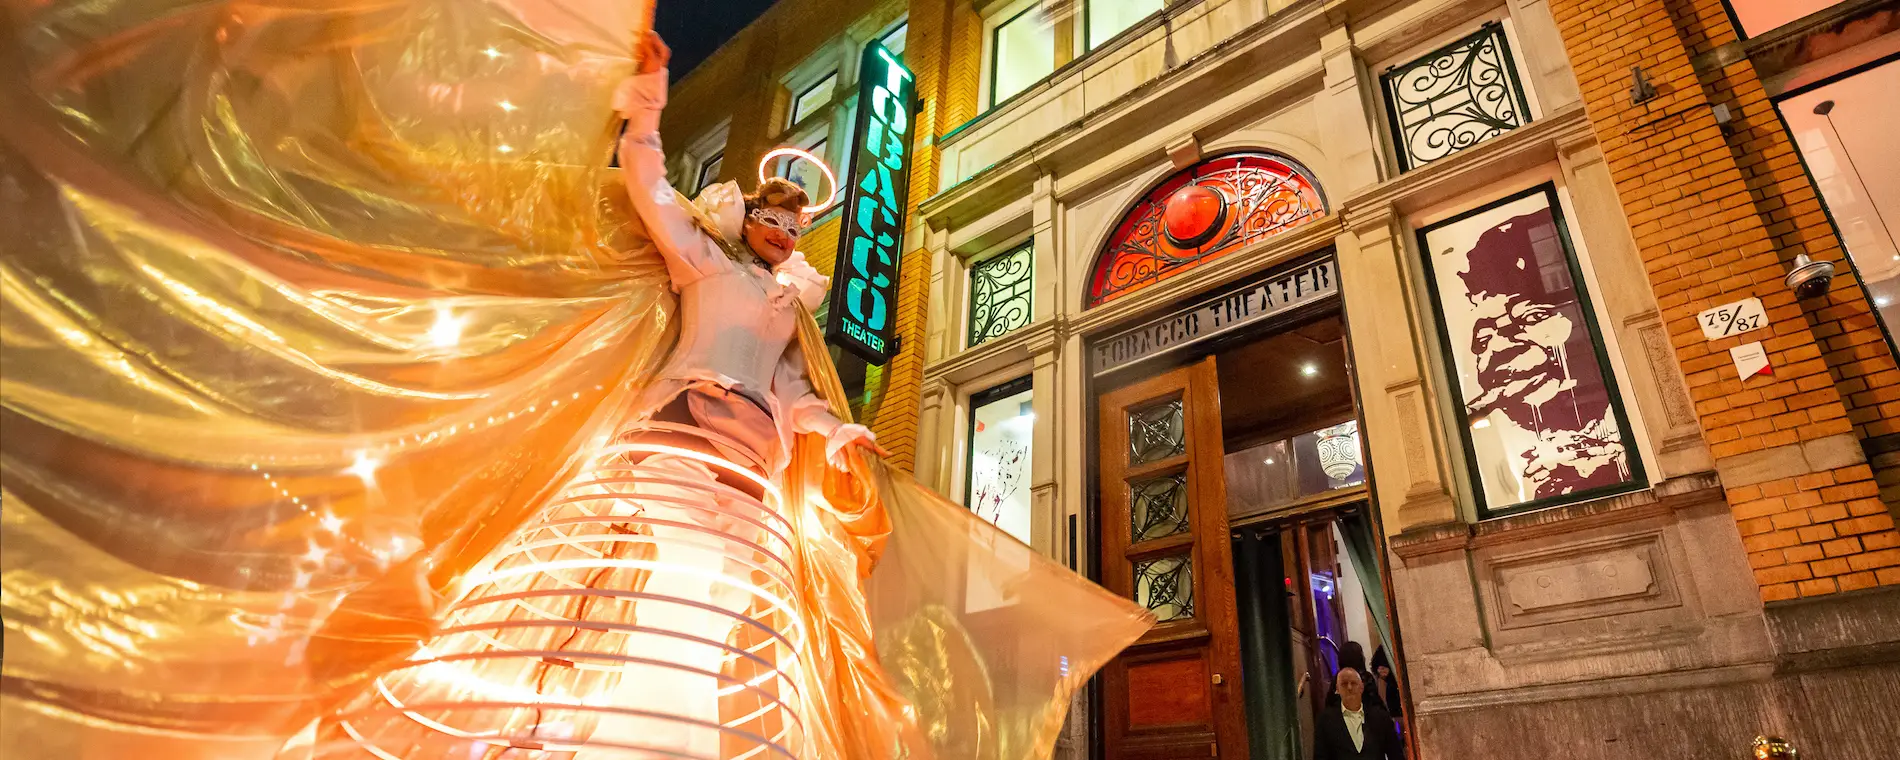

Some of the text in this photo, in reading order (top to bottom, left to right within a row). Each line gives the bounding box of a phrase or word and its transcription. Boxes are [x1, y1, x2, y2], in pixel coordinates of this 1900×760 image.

[846, 47, 913, 331] TOBACCO
[841, 317, 885, 353] THEATER
[1098, 265, 1328, 367] TOBACCO THEATER
[1705, 304, 1760, 335] 75/87
